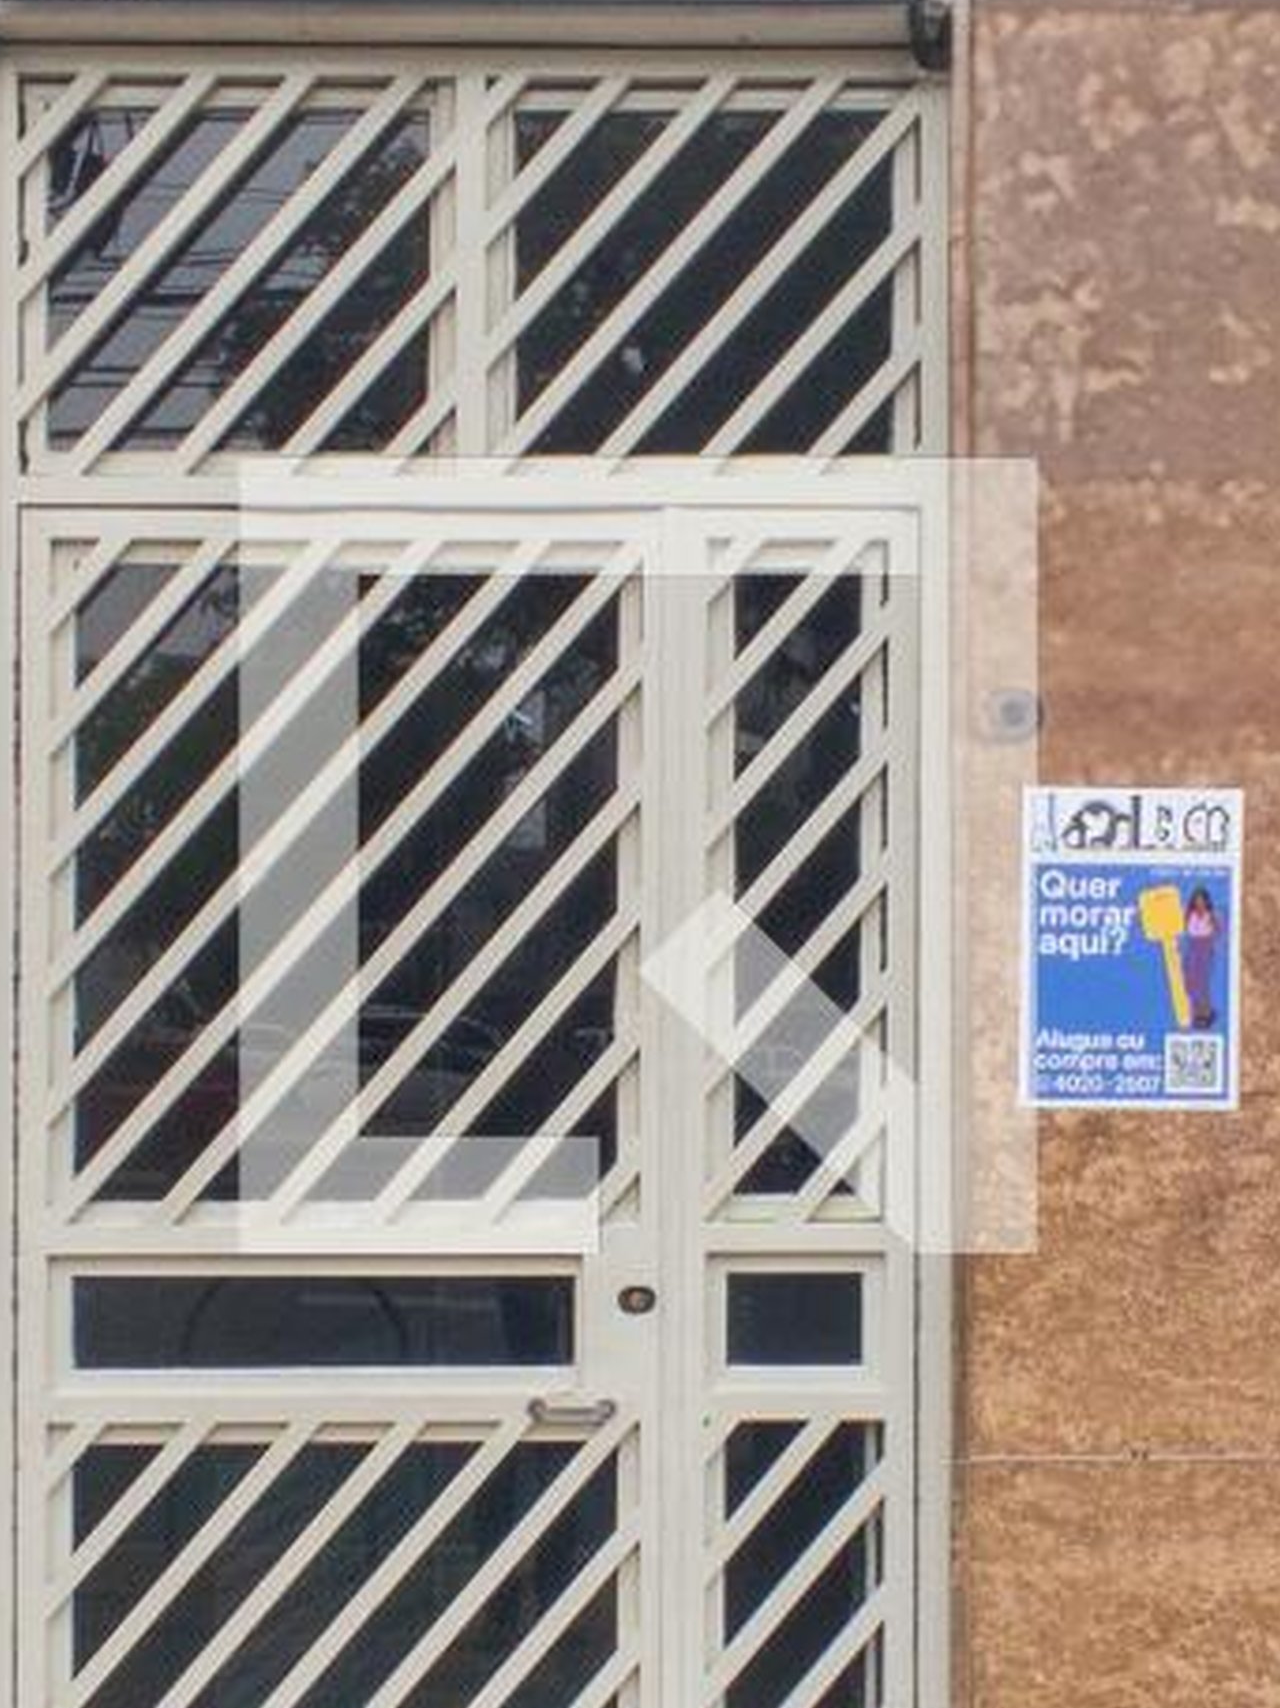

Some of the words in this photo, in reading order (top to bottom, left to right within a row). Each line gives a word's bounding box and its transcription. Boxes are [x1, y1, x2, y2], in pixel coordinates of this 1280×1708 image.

[1039, 870, 1121, 899] Quer
[1038, 904, 1136, 928] morar
[1038, 927, 1128, 961] aqui?
